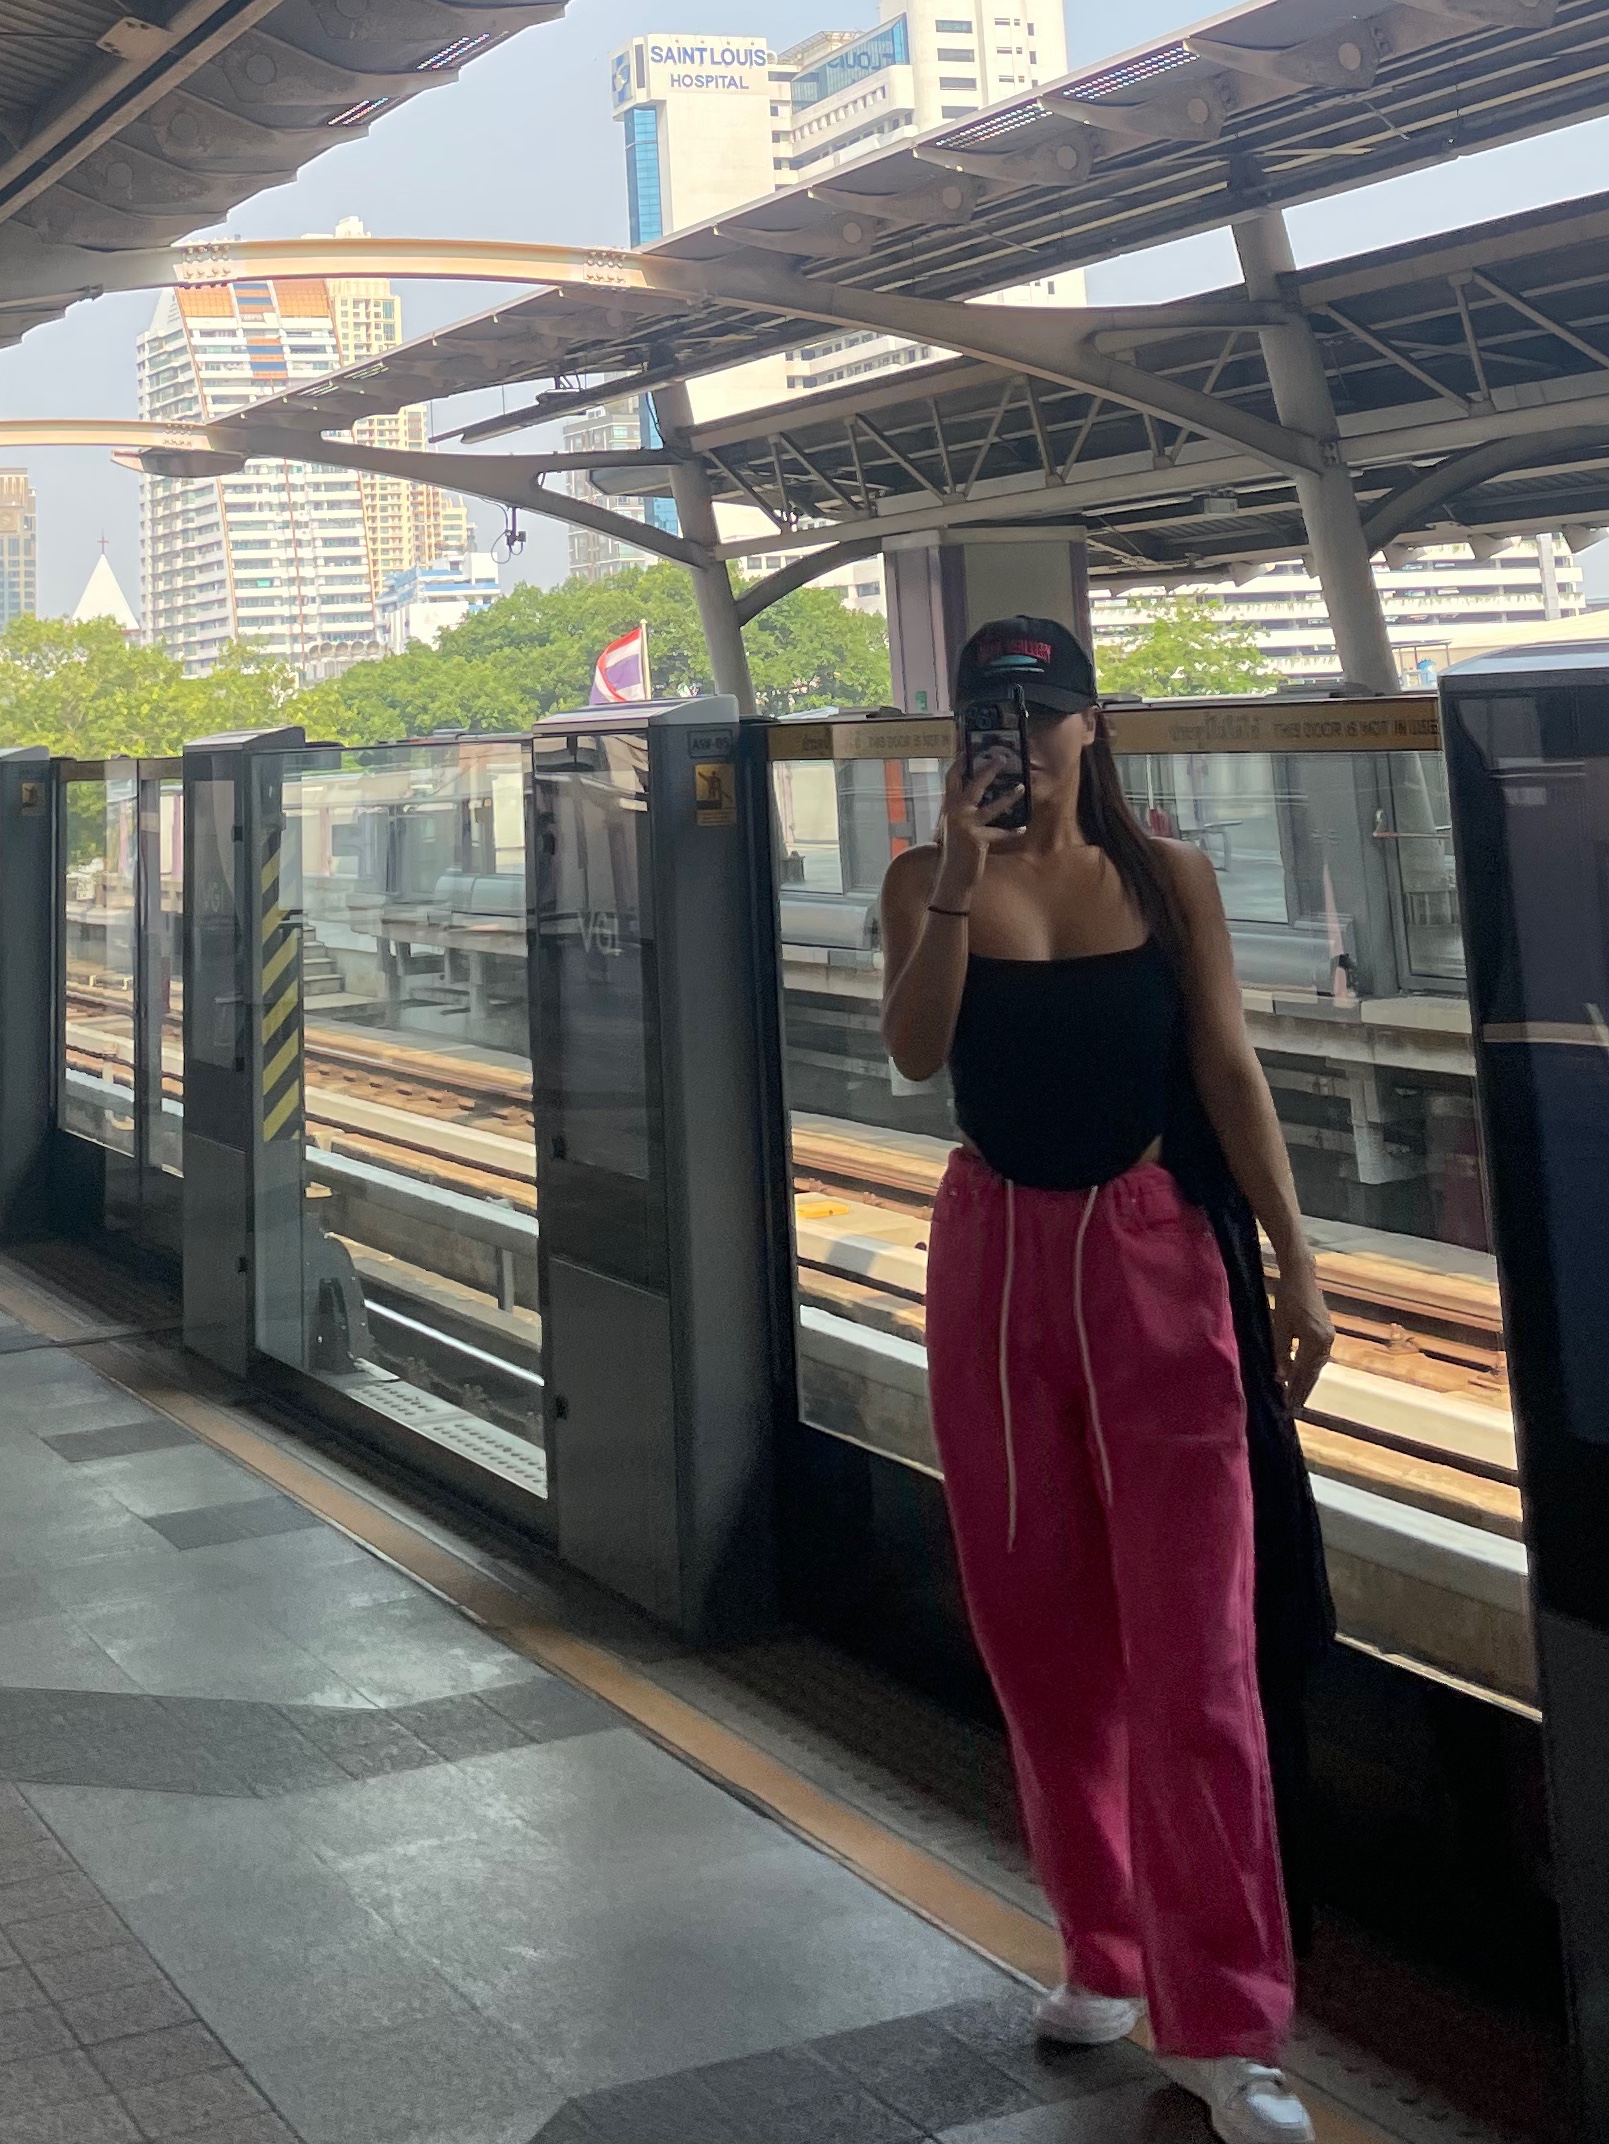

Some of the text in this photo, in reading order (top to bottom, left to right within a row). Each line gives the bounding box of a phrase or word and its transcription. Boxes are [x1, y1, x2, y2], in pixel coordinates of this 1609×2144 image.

[651, 46, 766, 66] SAINT LOUIS
[670, 74, 749, 89] HOSPITAL
